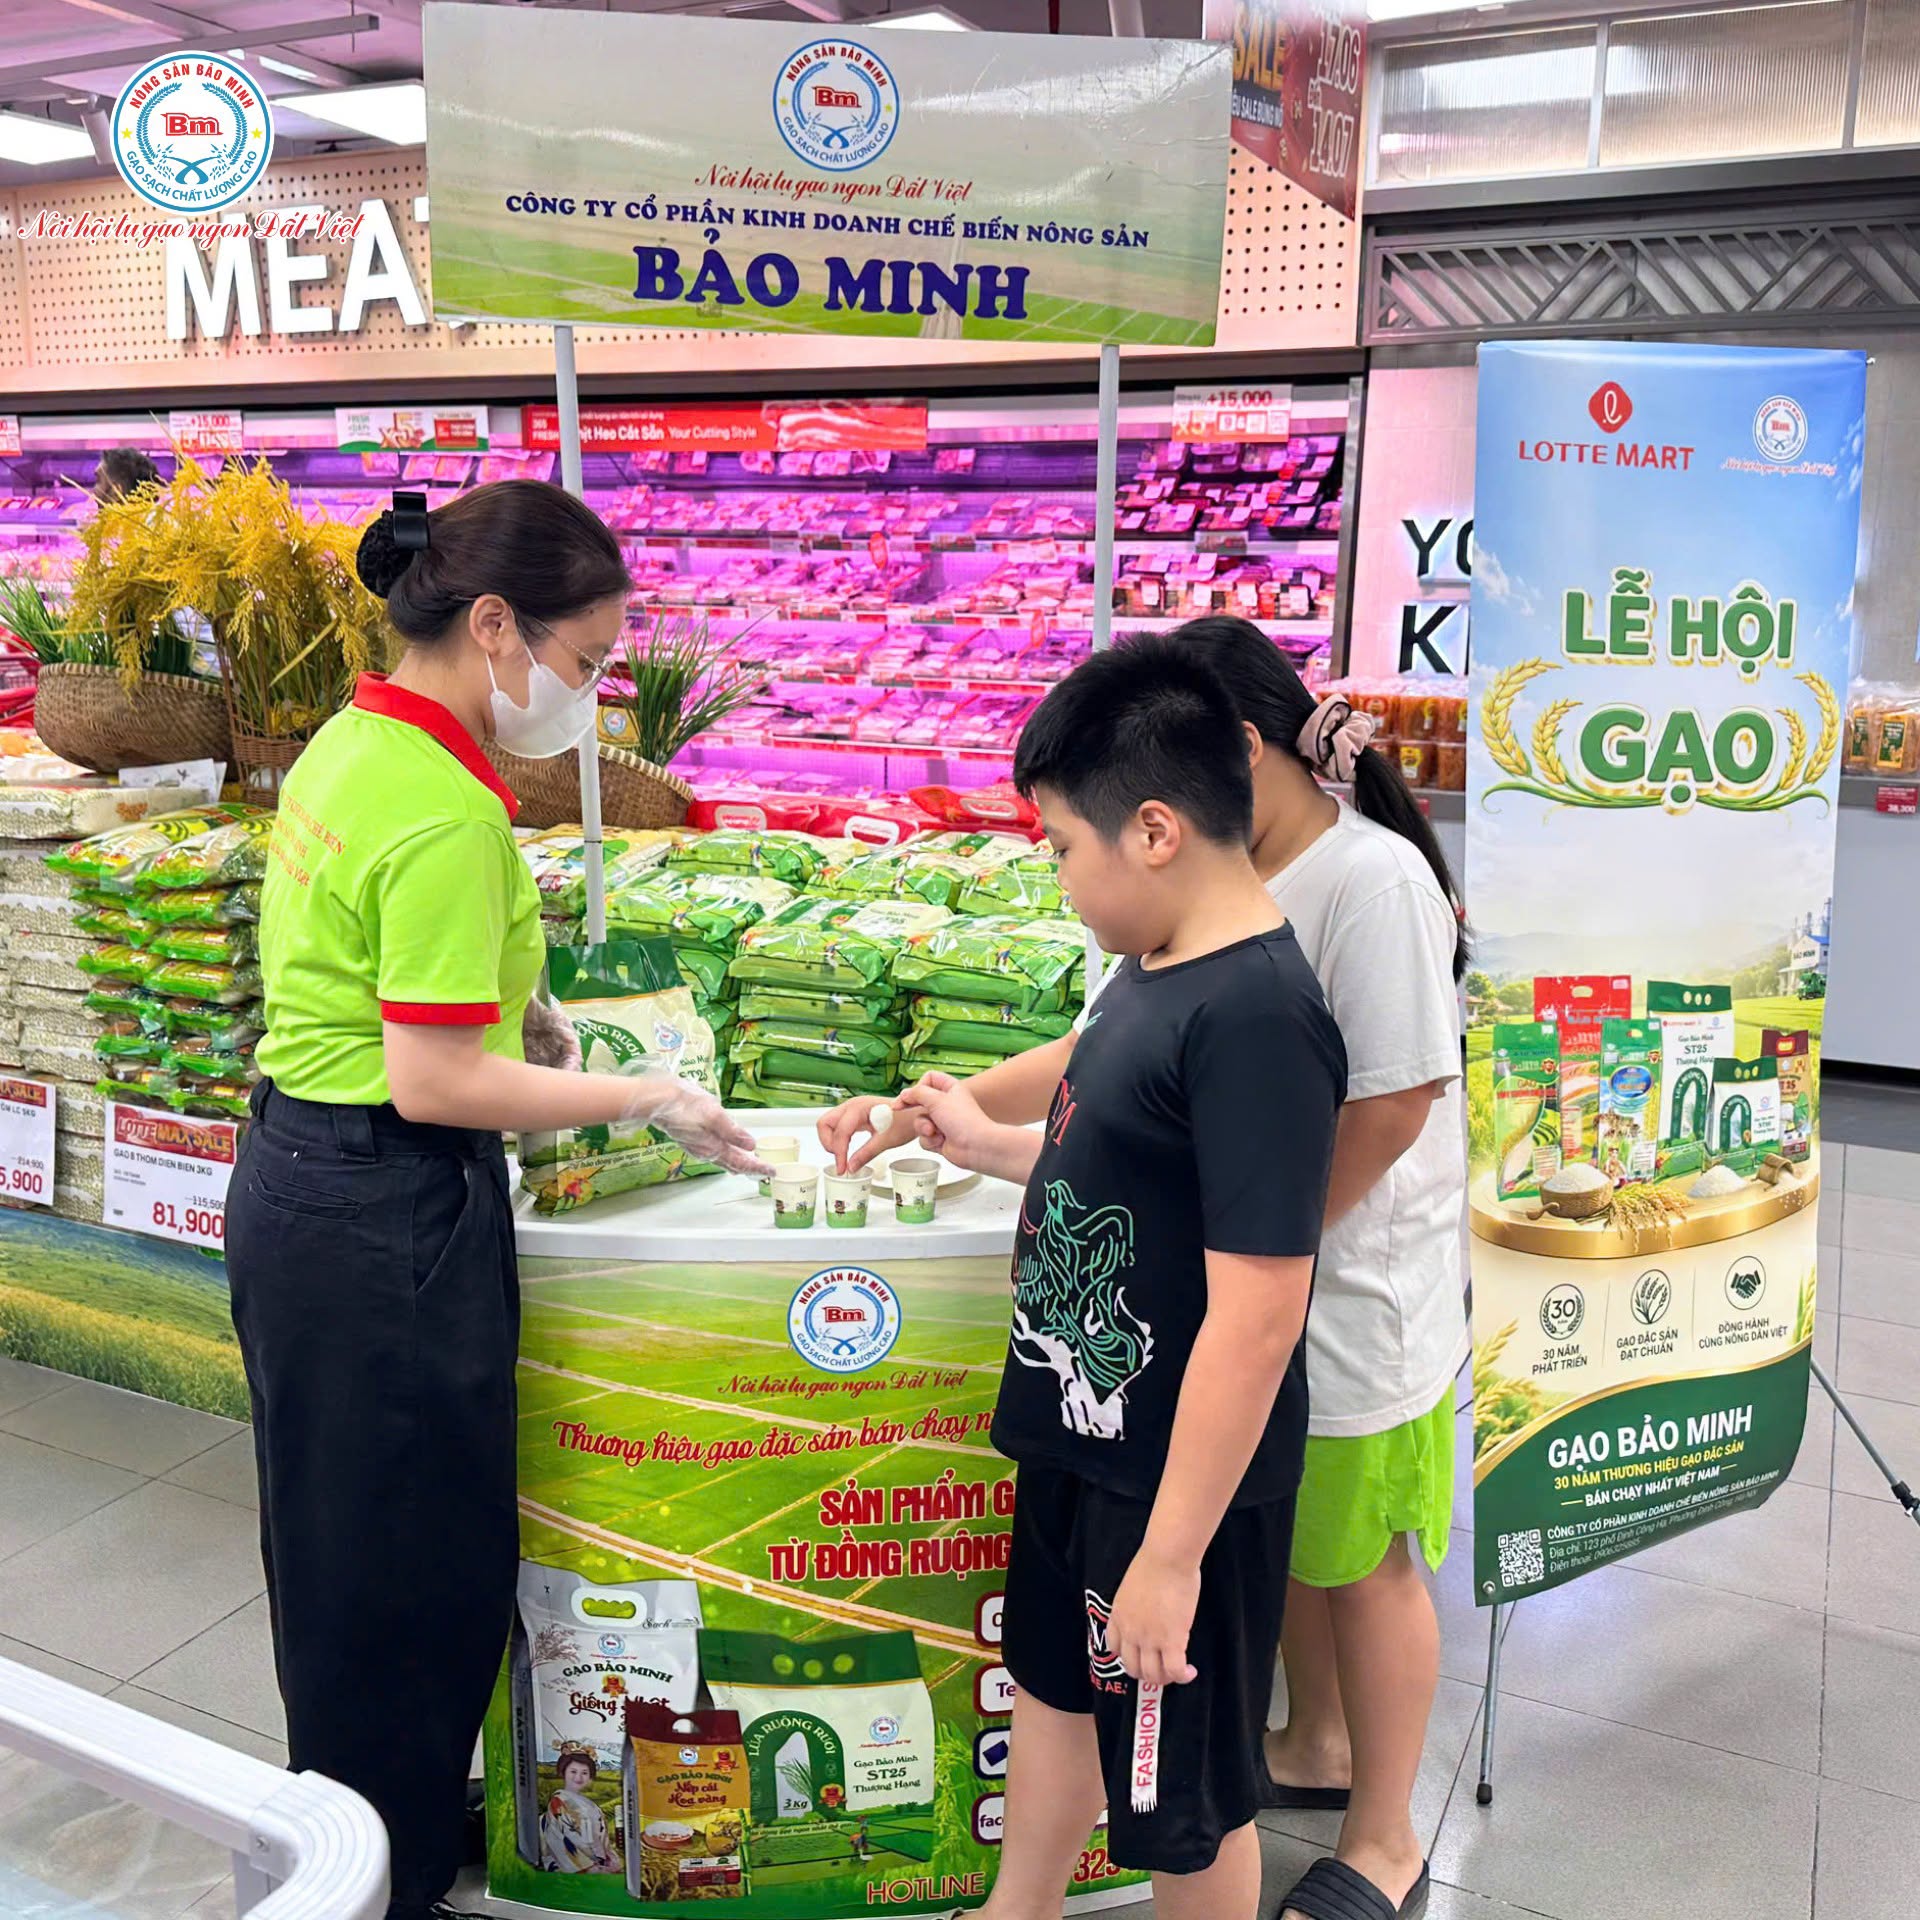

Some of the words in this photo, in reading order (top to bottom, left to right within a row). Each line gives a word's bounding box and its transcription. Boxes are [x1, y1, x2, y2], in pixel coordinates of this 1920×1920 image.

[787, 54, 812, 82] NÔNG
[813, 44, 835, 59] SẢN
[840, 47, 862, 62] BẢO
[863, 59, 888, 87] MINH
[812, 86, 862, 108] Bm
[695, 164, 739, 187] Nơi
[739, 166, 771, 194] hội
[772, 170, 792, 195] tụ
[791, 178, 834, 201] gạo
[832, 181, 882, 204] ngon
[886, 174, 925, 198] Đất
[930, 179, 972, 206] Việt
[506, 192, 576, 215] CÔNG
[584, 200, 617, 218] TY
[625, 193, 658, 220] CỔ
[666, 198, 735, 224] PHẦN
[743, 208, 805, 229] KINH
[813, 212, 901, 234] DOANH
[908, 213, 956, 238] CHẾ
[963, 216, 1019, 241] BIẾN
[1026, 222, 1094, 244] NÔNG
[1101, 223, 1150, 248] SẢN
[166, 197, 430, 340] MEA
[633, 228, 800, 308] BẢO
[823, 256, 1030, 320] MINH
[1518, 440, 1608, 465] LOTTE
[1616, 443, 1695, 471] MART
[1562, 567, 1656, 664] LỄ
[1667, 579, 1797, 684] HỘI
[1576, 703, 1778, 815] GẠO
[116, 1116, 157, 1139] LOTTE
[156, 1122, 191, 1146] MAX
[192, 1129, 231, 1153] SALE
[113, 1148, 129, 1159] GAO
[137, 1153, 157, 1165] THOM
[158, 1157, 176, 1169] DIEN
[177, 1161, 195, 1174] BIEN
[196, 1165, 213, 1177] 3KG
[153, 1201, 225, 1239] 81,900
[1551, 1299, 1575, 1319] 30
[1745, 1317, 1769, 1329] HÀNH
[1543, 1349, 1555, 1360] 30
[1557, 1344, 1580, 1358] NĂM
[1698, 1335, 1723, 1349] CÙNG
[1725, 1332, 1750, 1345] NÔNG
[1751, 1329, 1769, 1341] DÂN
[1532, 1359, 1559, 1375] PHÁT
[1561, 1354, 1588, 1371] TRIỂN
[718, 1374, 757, 1394] Nơi
[756, 1374, 784, 1397] hội
[804, 1381, 839, 1400] gạo
[841, 1380, 887, 1399] ngon
[890, 1369, 926, 1391] Đất
[932, 1369, 968, 1390] Việt
[552, 1420, 650, 1467] Thương
[650, 1430, 706, 1466] hiệu
[702, 1439, 757, 1470] gạo
[758, 1426, 807, 1460] đặc
[807, 1424, 857, 1453] sản
[859, 1415, 909, 1448] bán
[911, 1407, 976, 1443] chạy
[1548, 1431, 1610, 1472] GẠO
[1617, 1413, 1679, 1459] BẢO
[1686, 1404, 1753, 1447] MINH
[1554, 1475, 1569, 1490] 30
[1572, 1469, 1601, 1488] NĂM
[1602, 1462, 1652, 1483] THƯƠNG
[1654, 1457, 1679, 1475] HIỆU
[1681, 1452, 1702, 1470] GẠO
[1703, 1446, 1724, 1465] ĐẶC
[1724, 1439, 1744, 1456] SẢN
[819, 1477, 885, 1527] SẢN
[891, 1467, 987, 1525] PHẨM
[1585, 1489, 1610, 1507] BÁN
[1611, 1483, 1642, 1502] CHẠY
[1645, 1477, 1673, 1495] NHẤT
[1675, 1470, 1696, 1488] VIỆT
[1697, 1465, 1720, 1481] NAM
[1547, 1525, 1574, 1540] CÔNG
[1576, 1523, 1588, 1535] TY
[1589, 1517, 1602, 1531] CỔ
[1603, 1513, 1628, 1528] PHẦN
[1628, 1509, 1648, 1522] KINH
[1648, 1501, 1675, 1517] DOANH
[1676, 1494, 1691, 1508] CHẾ
[1709, 1483, 1729, 1498] NÔNG
[768, 1536, 810, 1581] TỪ
[813, 1528, 902, 1580] ĐỒNG
[909, 1527, 1013, 1581] RUỘNG
[562, 1664, 592, 1679] GẠO
[594, 1660, 627, 1674] BẢO
[629, 1664, 674, 1684] MINH
[569, 1690, 618, 1724] Giống
[748, 1733, 765, 1756] LÚA
[761, 1715, 813, 1735] RUỘNG
[1137, 1698, 1157, 1788] FASHION
[853, 1759, 875, 1770] Gạo
[875, 1756, 894, 1766] Bảo
[895, 1754, 918, 1764] Minh
[866, 1766, 907, 1781] ST25
[783, 1798, 791, 1809] 3
[794, 1800, 808, 1811] Kg
[853, 1783, 892, 1794] Thượng
[894, 1778, 921, 1790] Hạng
[867, 1872, 985, 1905] HOTLINE
